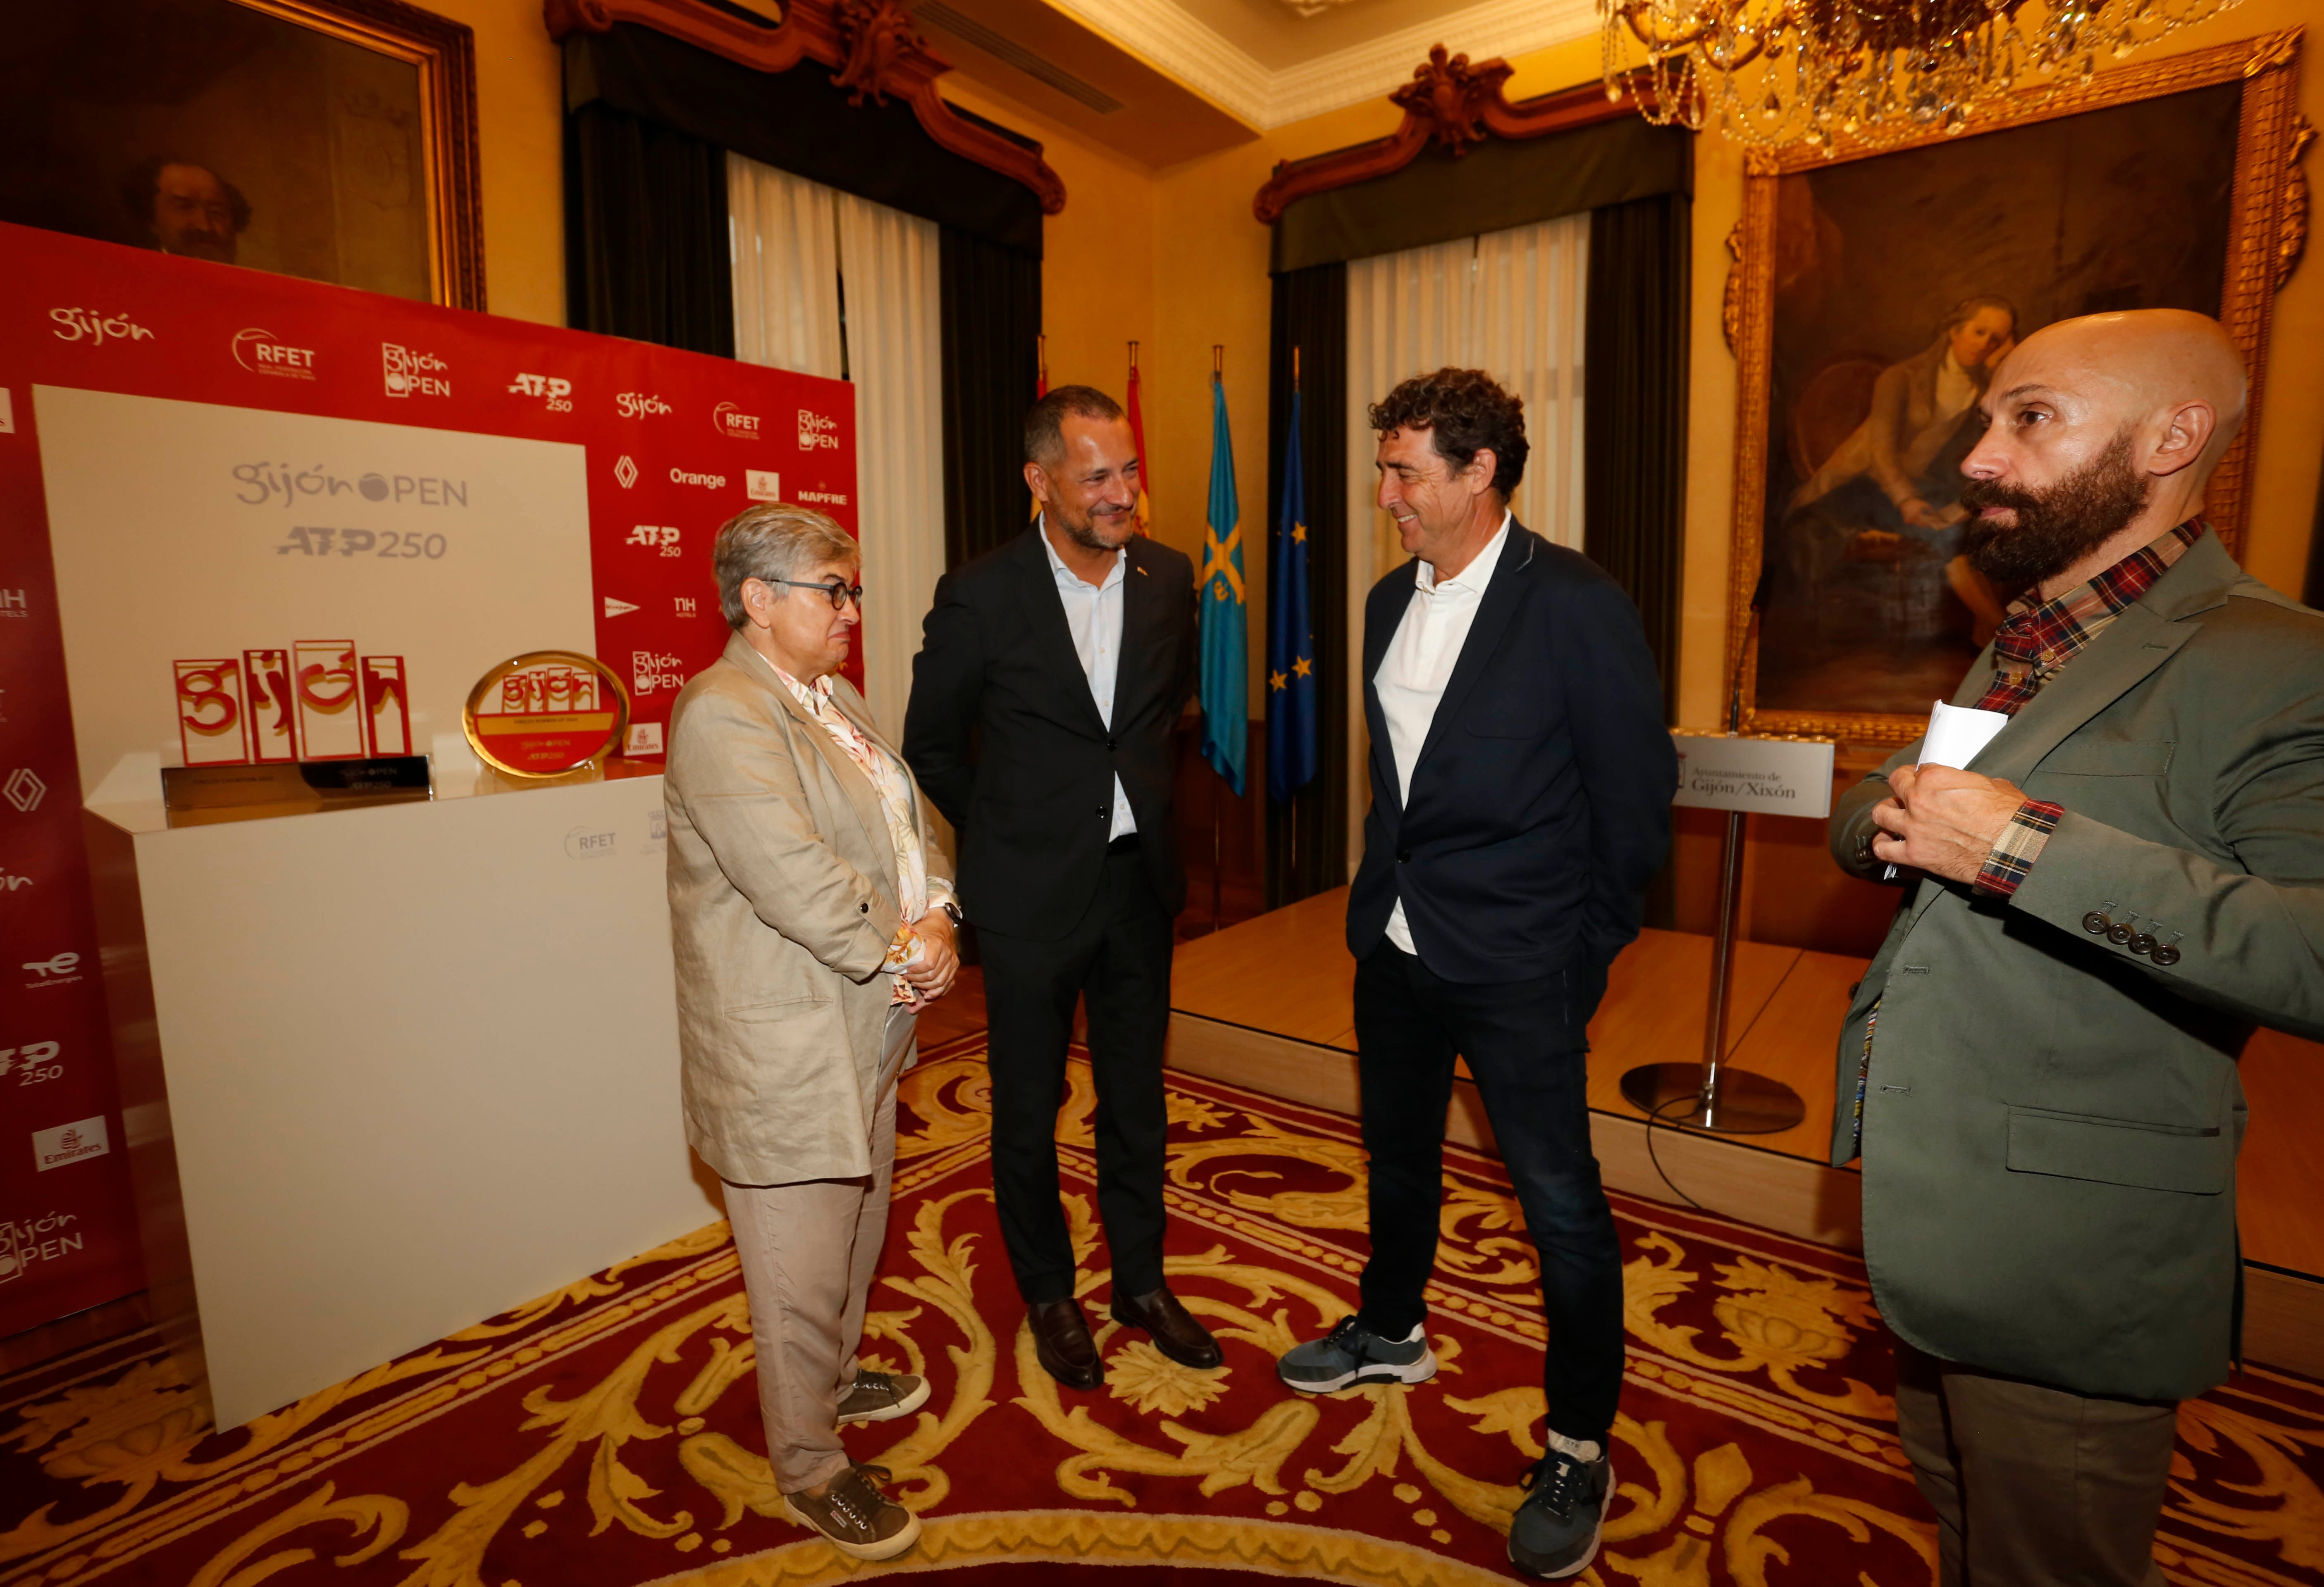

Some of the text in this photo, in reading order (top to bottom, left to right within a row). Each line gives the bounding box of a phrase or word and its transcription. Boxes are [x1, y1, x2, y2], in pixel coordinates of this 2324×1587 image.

[50, 307, 155, 346] gijón
[256, 342, 315, 368] RFET
[507, 372, 572, 398] ATP
[546, 398, 573, 413] 250
[616, 392, 672, 420] gijón
[726, 413, 760, 430] RFET
[232, 461, 353, 508] gijón
[670, 468, 726, 489] Orange
[798, 491, 847, 505] MAPFRE
[624, 524, 680, 546] ATP
[659, 546, 681, 558] 250
[1692, 767, 1781, 780] Ayuntamiento de
[1692, 777, 1795, 798] Gijón/Xixón
[580, 833, 616, 850] RFET
[19, 1065, 63, 1086] 250
[44, 1143, 102, 1165] Emirates
